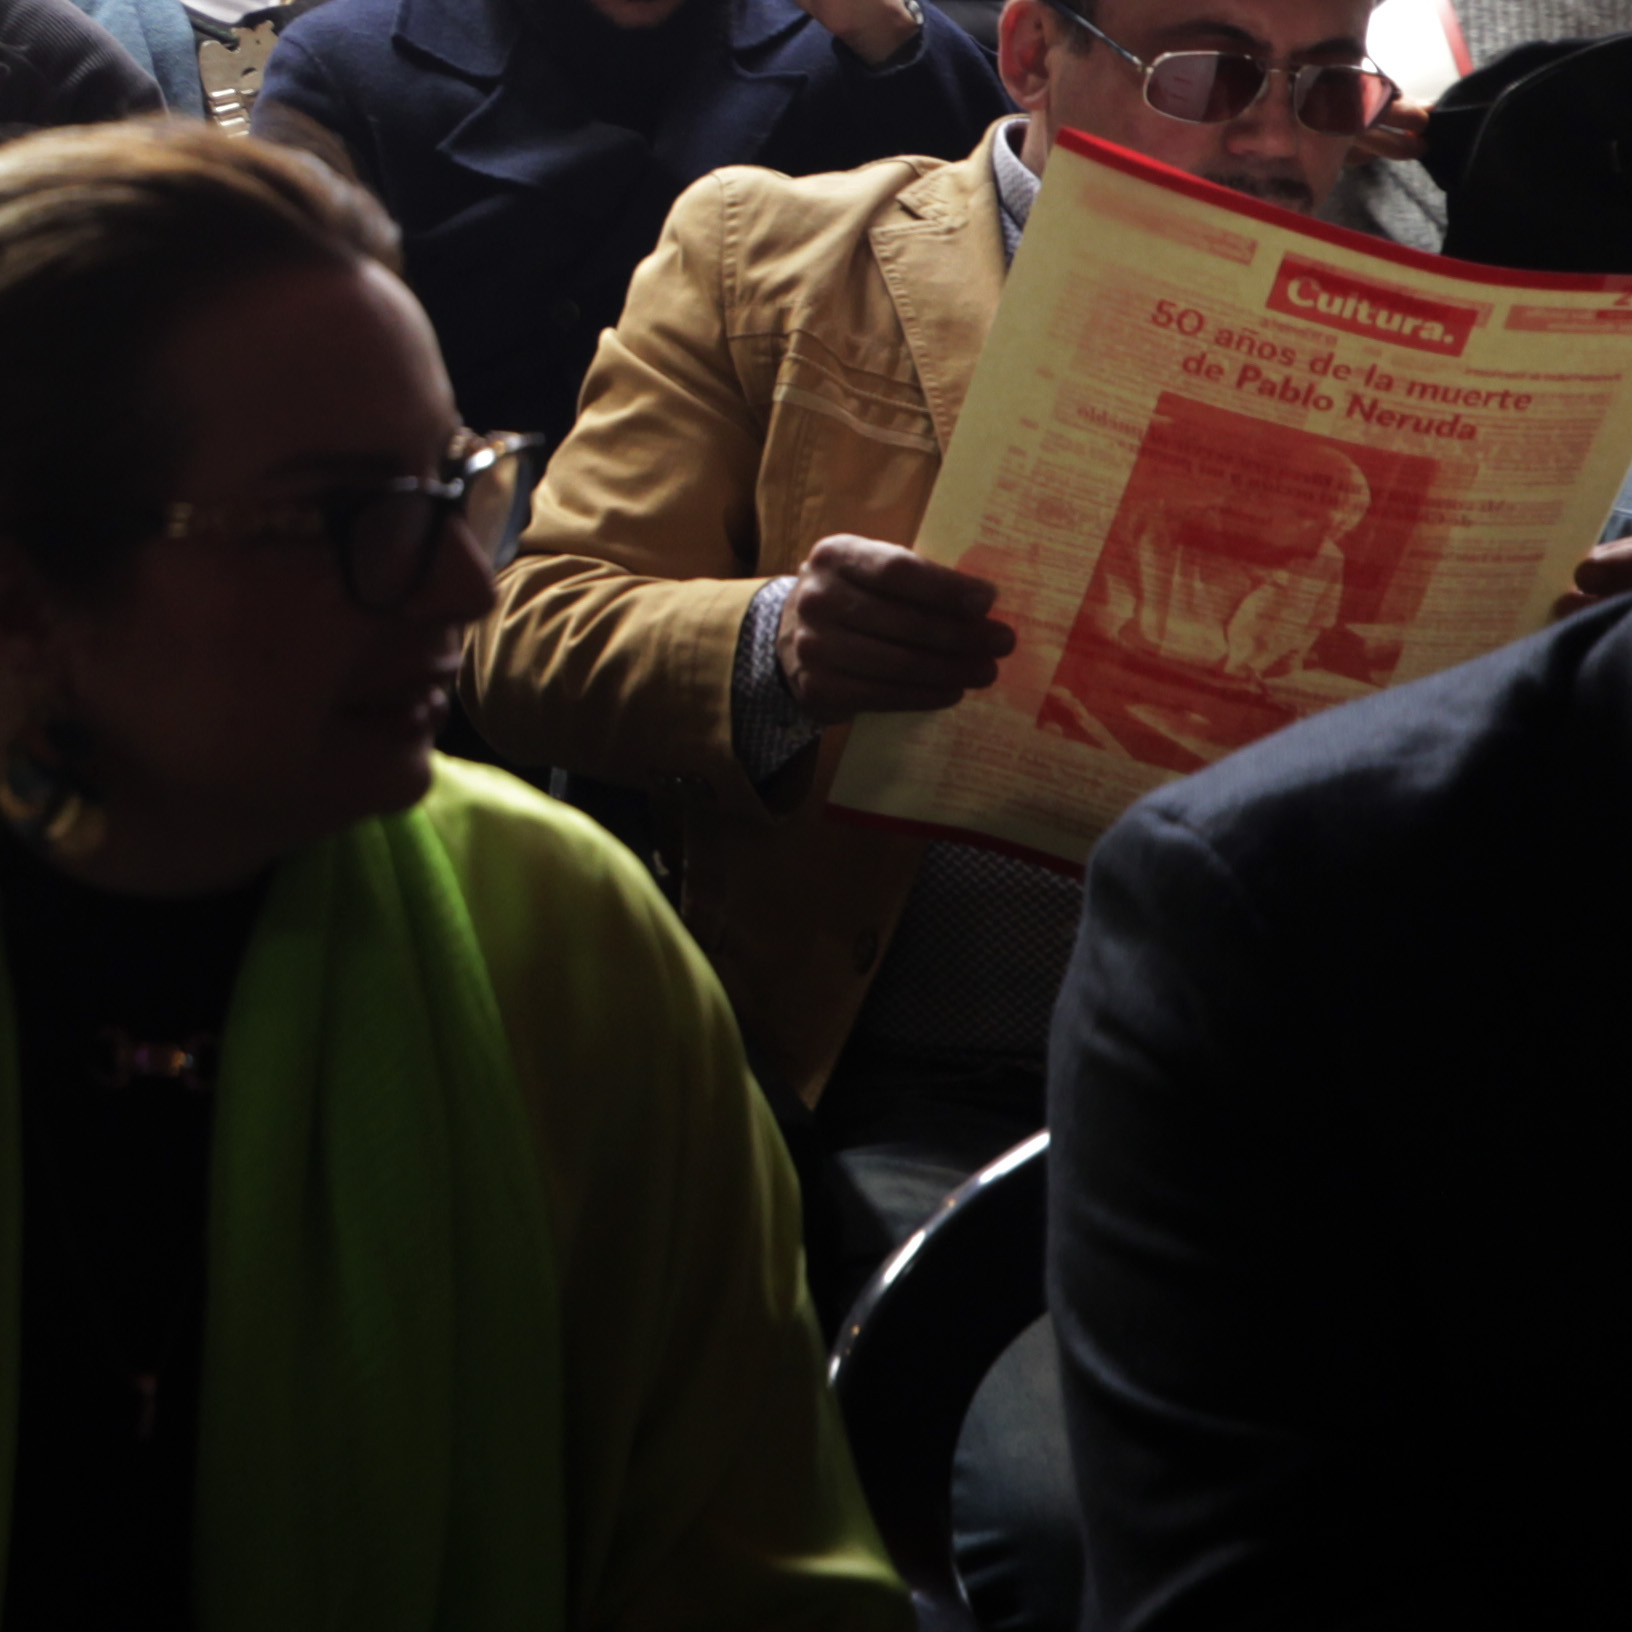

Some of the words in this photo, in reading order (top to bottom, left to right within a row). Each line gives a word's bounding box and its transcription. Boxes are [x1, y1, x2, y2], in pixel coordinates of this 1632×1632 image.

[1150, 298, 1205, 337] 50
[1213, 325, 1298, 368] años
[1308, 351, 1353, 381] de
[1363, 362, 1395, 394] la
[1404, 382, 1534, 412] muerte
[1286, 276, 1456, 346] Cultura.
[1181, 351, 1226, 382] de
[1235, 363, 1335, 413] Pablo
[1345, 393, 1478, 443] Neruda
